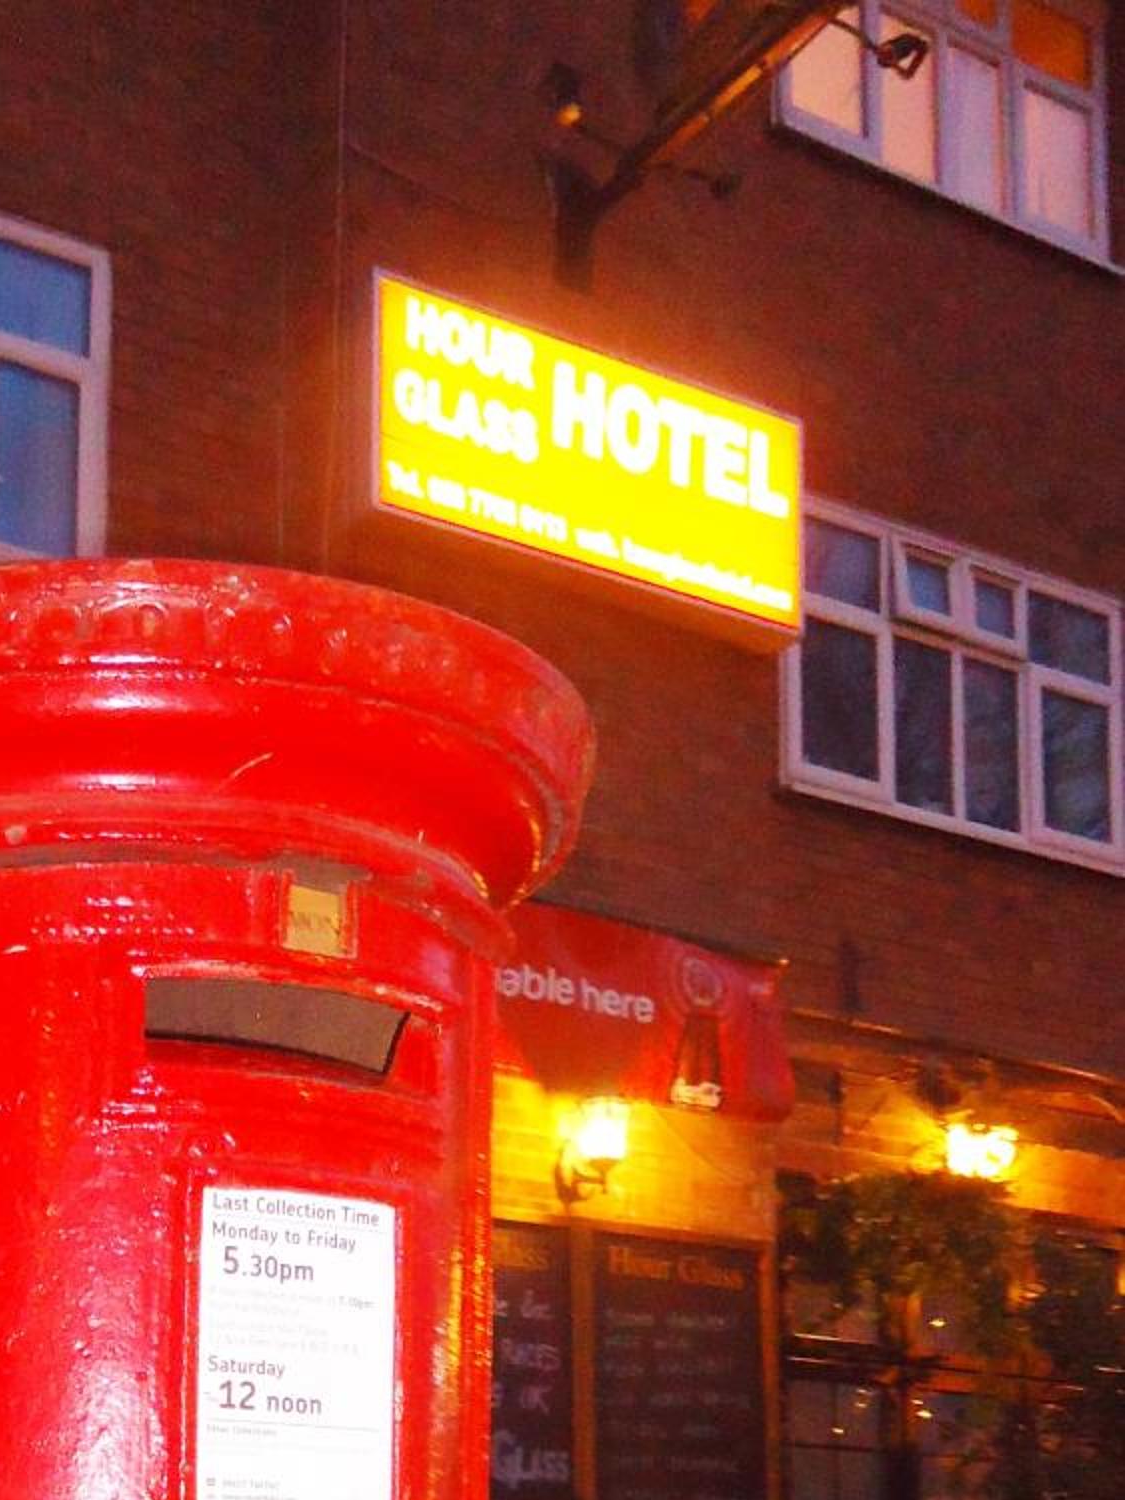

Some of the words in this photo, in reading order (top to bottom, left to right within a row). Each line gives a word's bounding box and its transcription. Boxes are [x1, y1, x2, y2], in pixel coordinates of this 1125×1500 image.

[405, 297, 535, 389] HOUR
[394, 369, 538, 463] GLASS
[552, 361, 788, 517] HOTEL
[579, 976, 655, 1024] here
[212, 1192, 249, 1212] Last
[256, 1196, 336, 1222] Collection
[340, 1205, 380, 1227] Time
[211, 1220, 279, 1246] Monday
[284, 1230, 301, 1245] to
[307, 1230, 357, 1254] Friday
[223, 1245, 315, 1284] 5.30pm
[207, 1355, 286, 1380] Saturday
[219, 1379, 256, 1411] 12
[266, 1395, 322, 1415] noon
